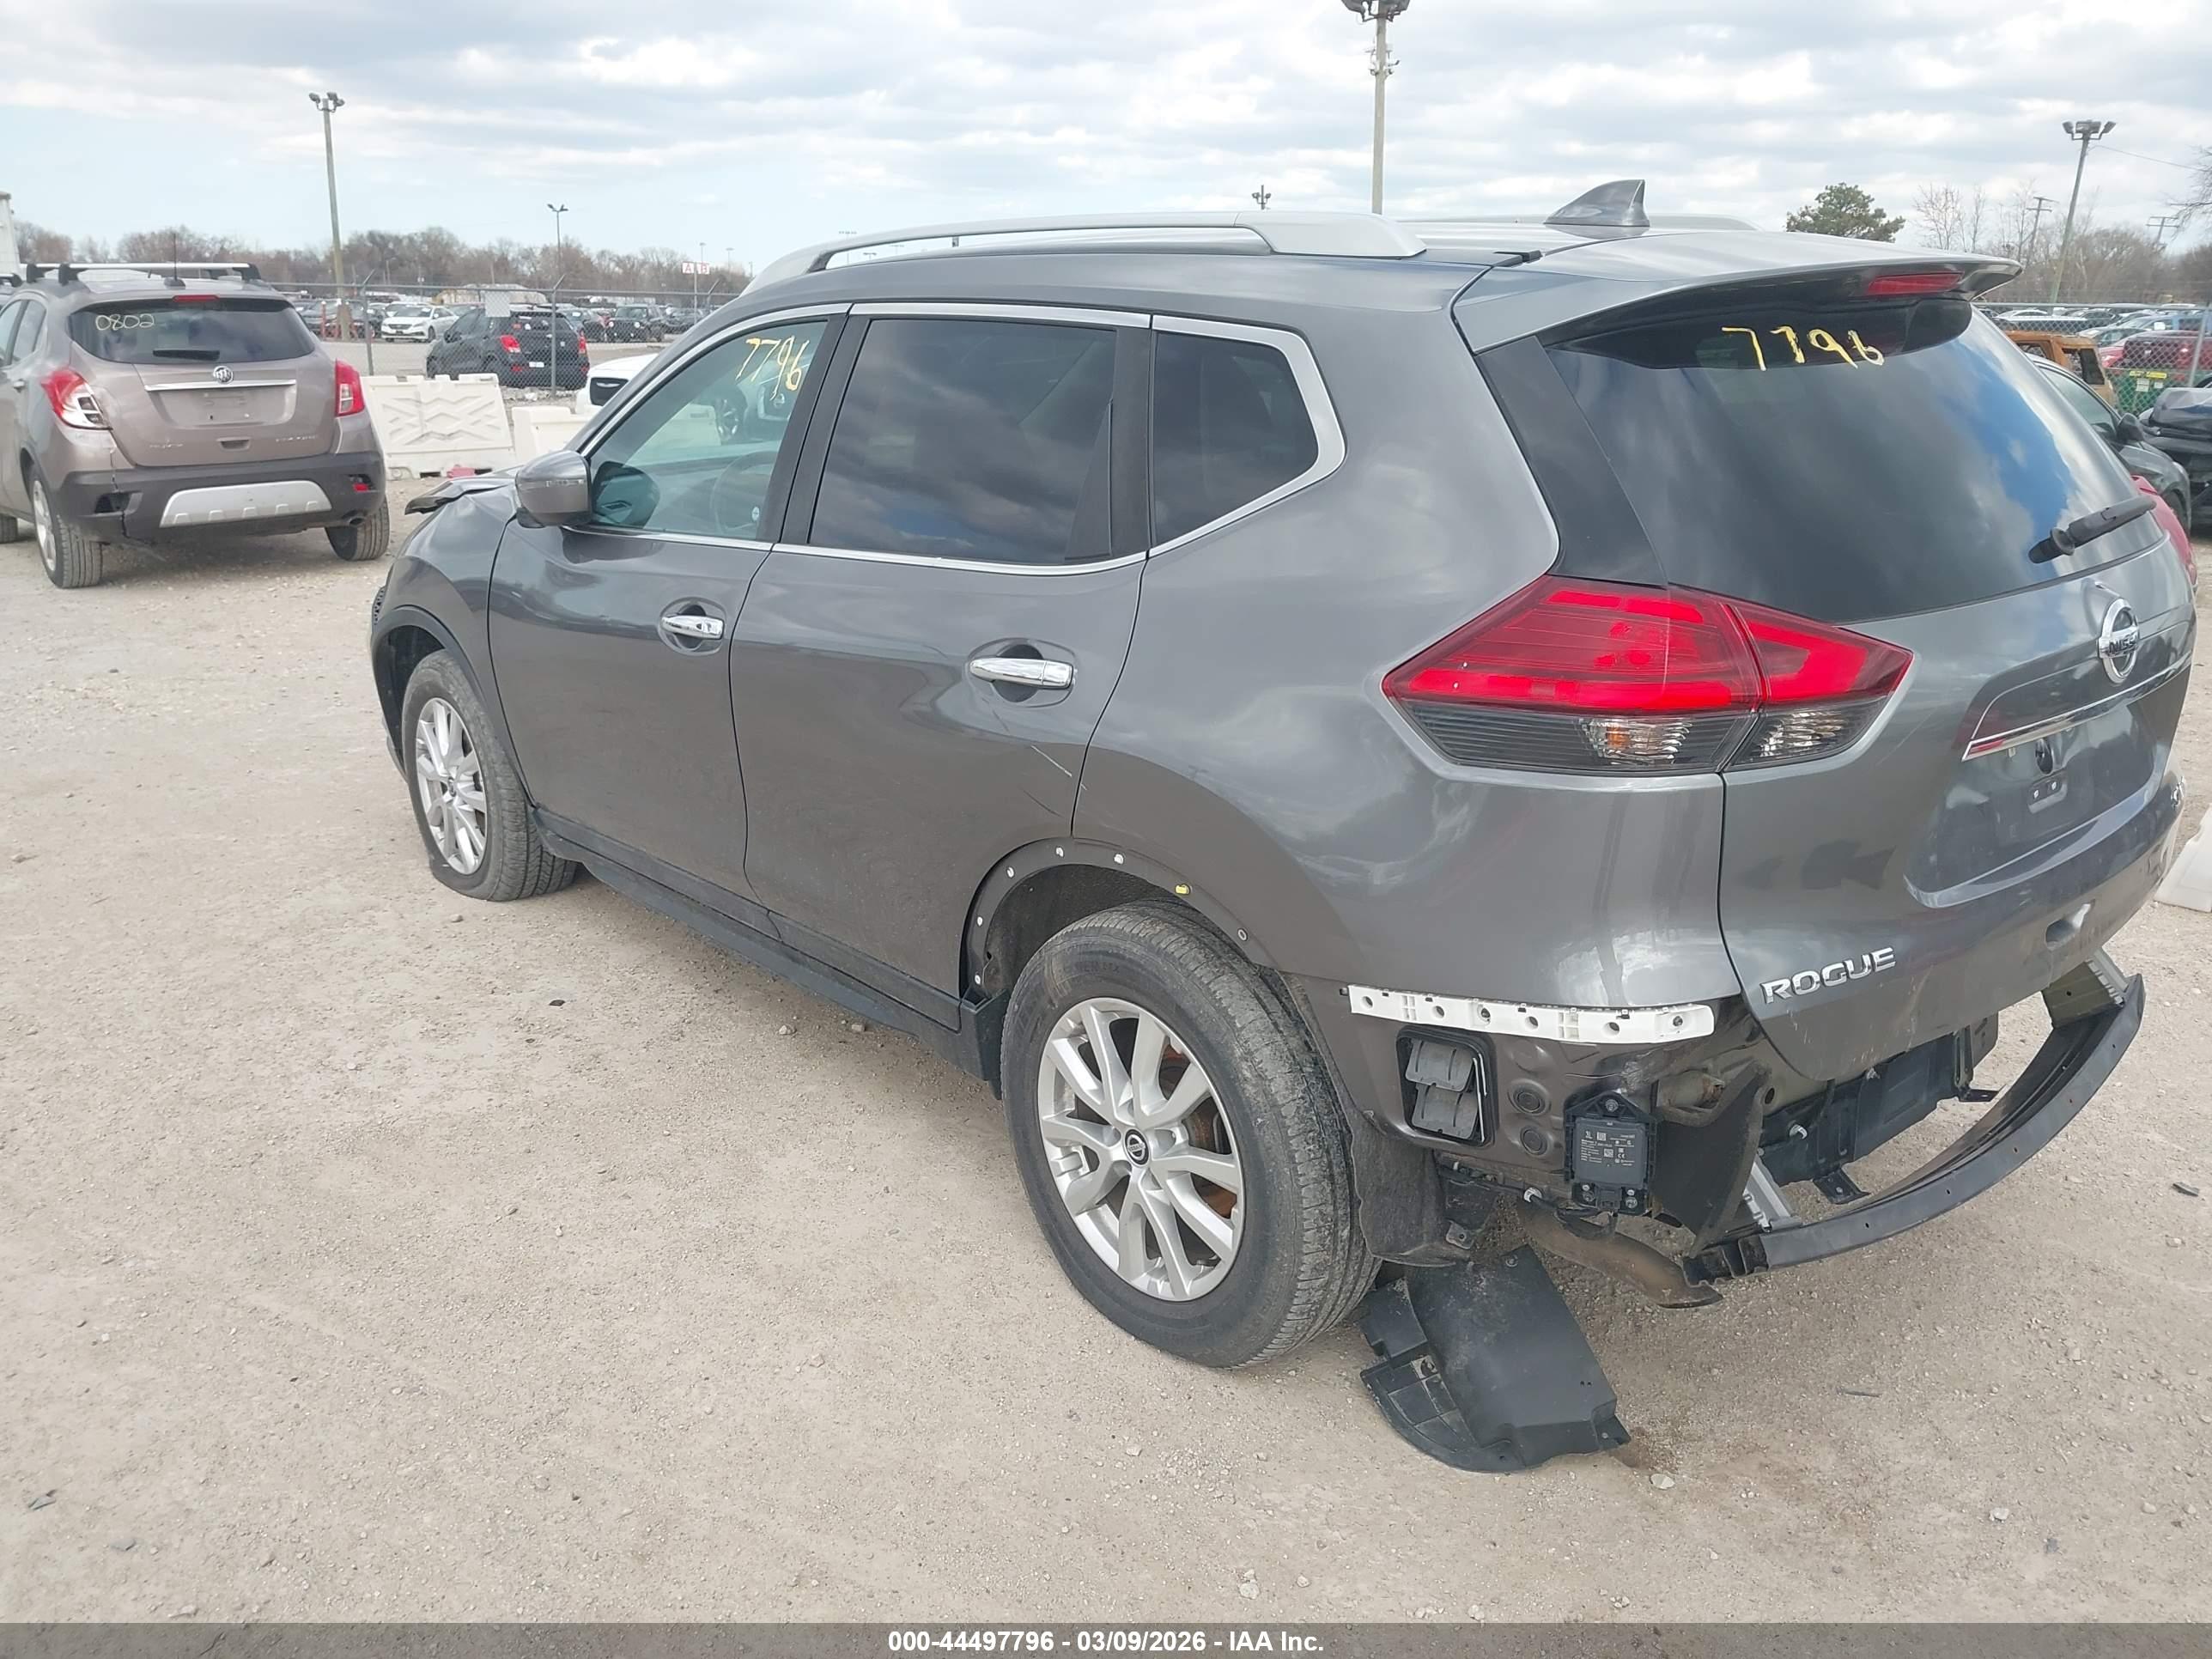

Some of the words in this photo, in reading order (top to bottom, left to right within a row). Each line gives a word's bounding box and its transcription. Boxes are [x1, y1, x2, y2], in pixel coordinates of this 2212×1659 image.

[95, 313, 155, 331] 0802
[734, 335, 811, 401] 7796
[1721, 325, 1885, 372] 7796
[1760, 946, 1897, 1004] ROGUE
